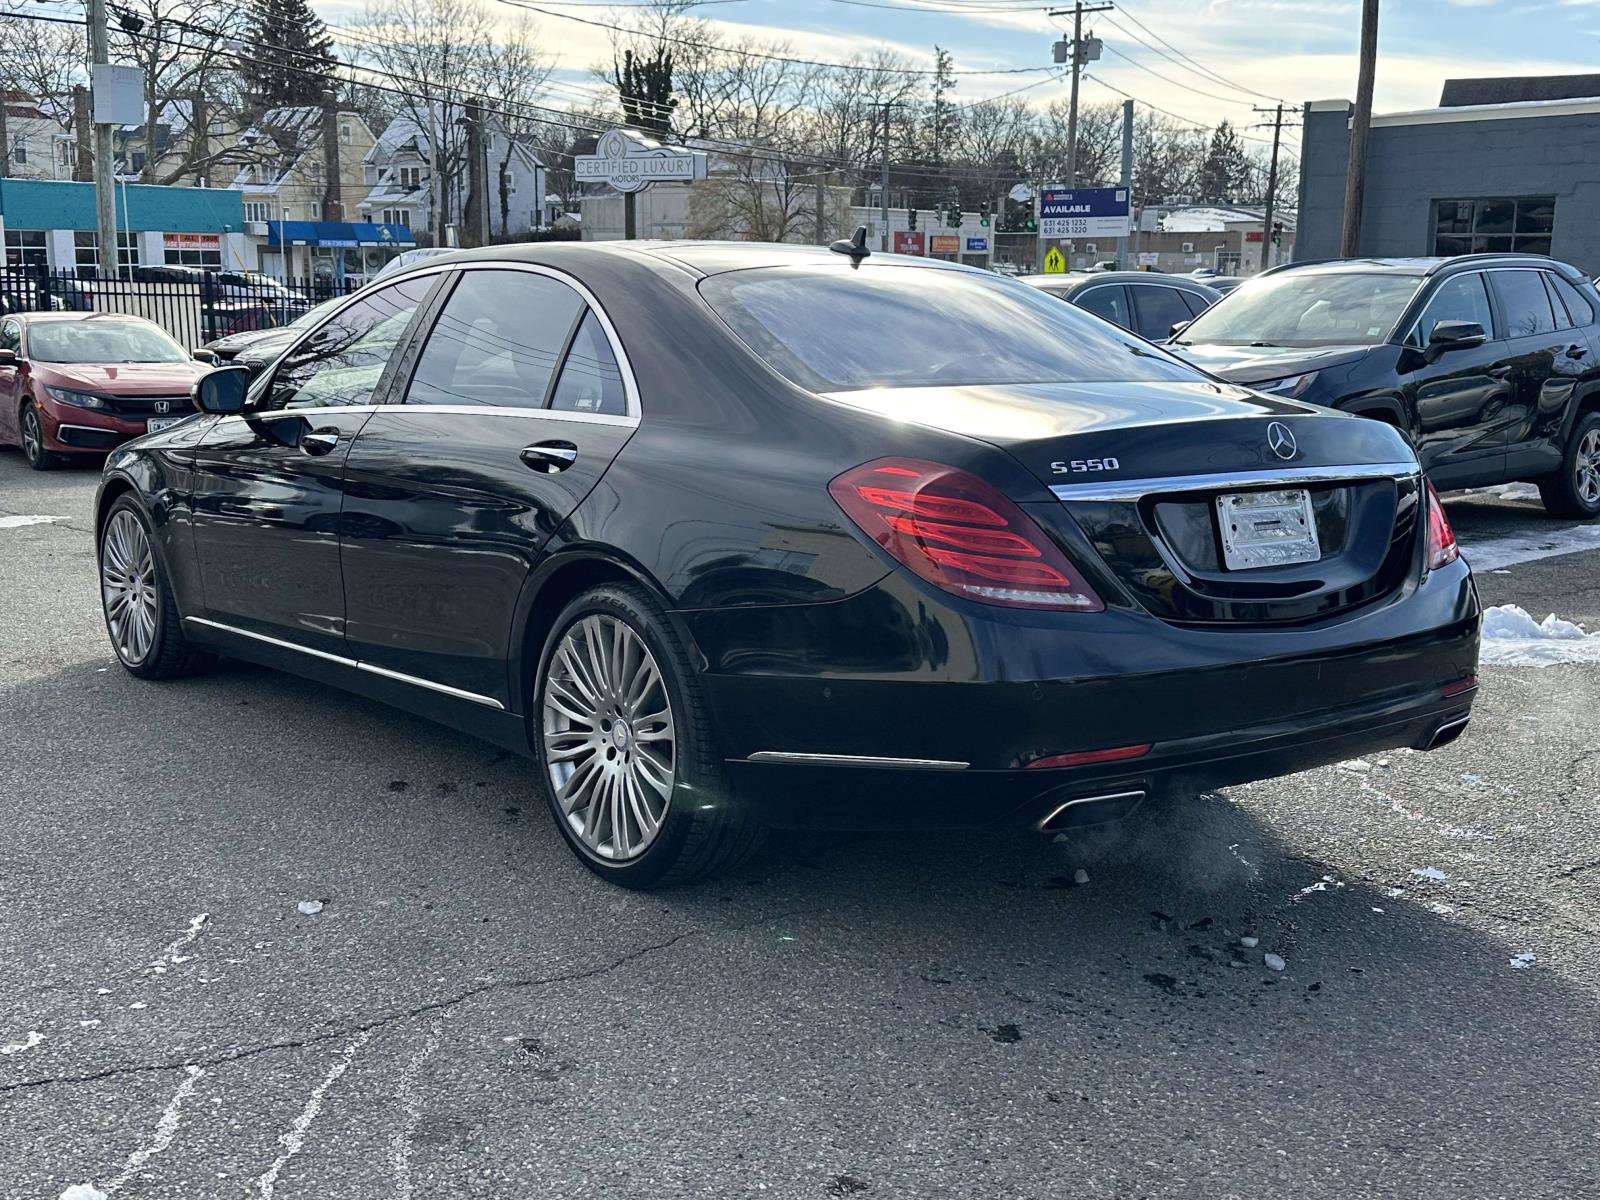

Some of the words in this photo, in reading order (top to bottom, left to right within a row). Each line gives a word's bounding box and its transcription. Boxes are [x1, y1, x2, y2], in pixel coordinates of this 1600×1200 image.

[576, 161, 638, 174] CERTIFIED
[643, 159, 692, 173] LUXURY
[611, 175, 640, 183] MOTORS
[1043, 205, 1091, 213] AVAILABLE
[1051, 461, 1068, 474] S
[1070, 457, 1119, 473] 550
